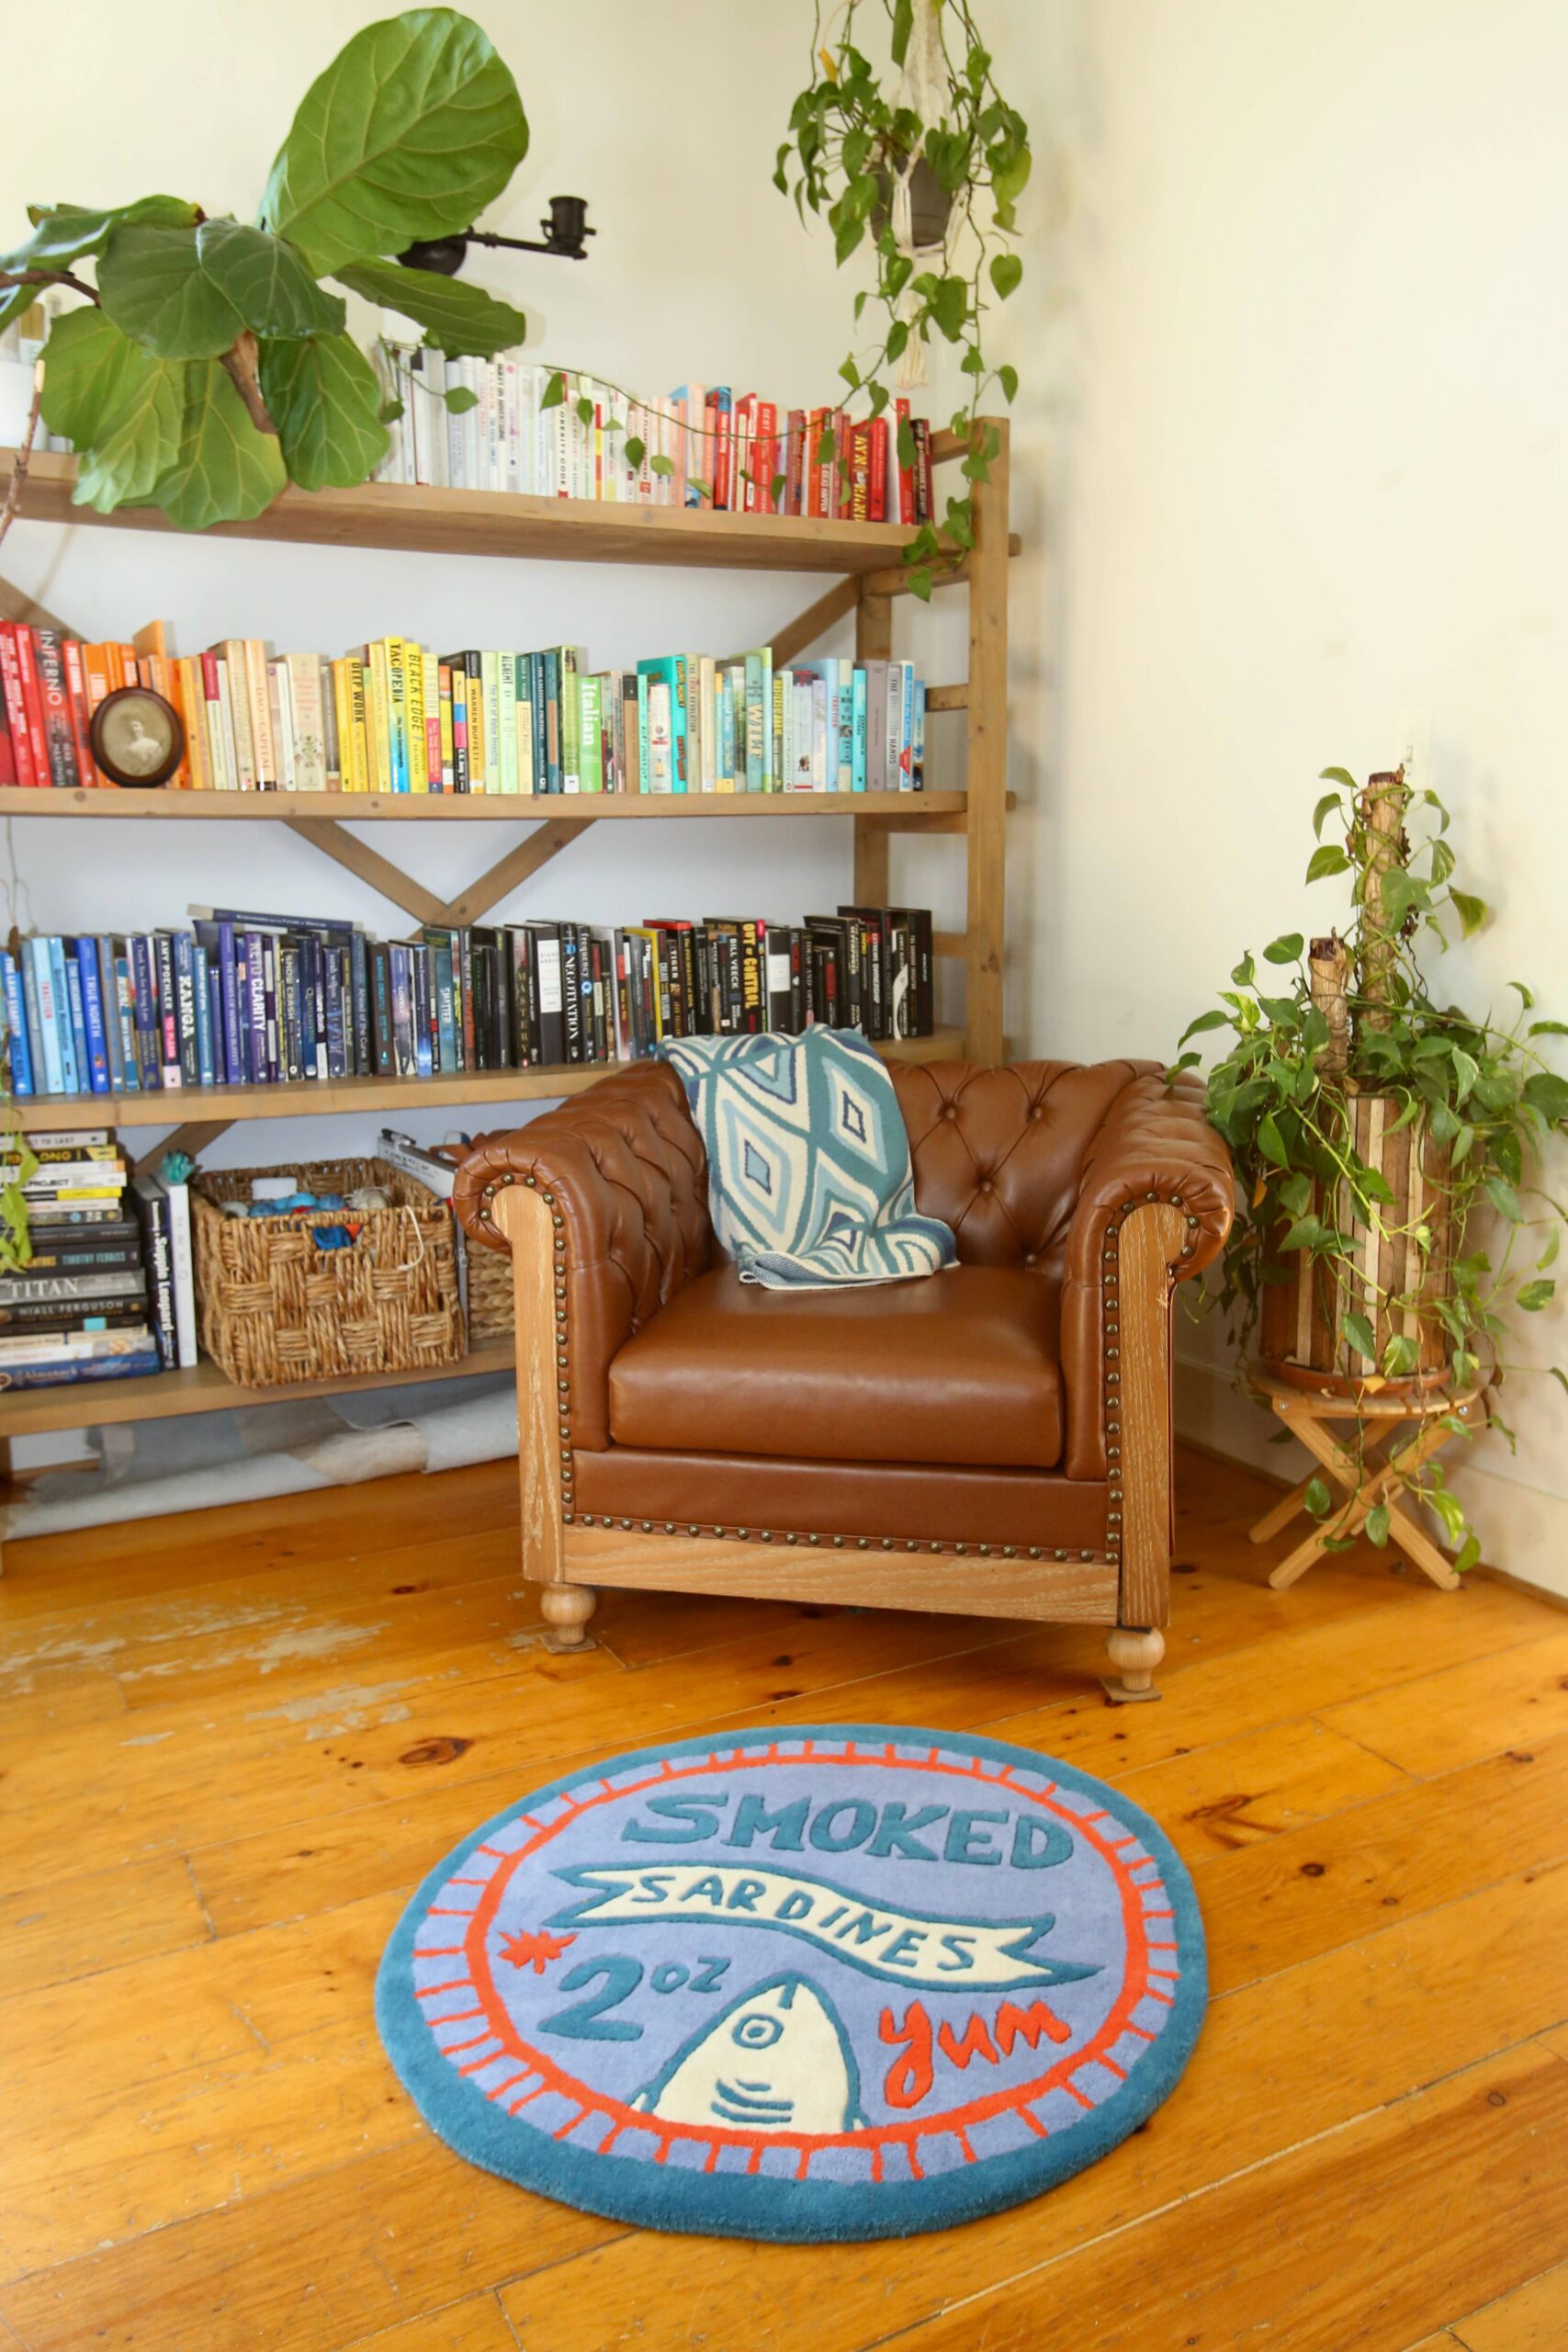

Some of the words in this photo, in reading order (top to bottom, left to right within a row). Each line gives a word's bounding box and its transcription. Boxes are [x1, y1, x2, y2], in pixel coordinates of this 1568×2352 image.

[761, 408, 770, 431] DEBT
[854, 435, 868, 465] AYN
[853, 484, 866, 522] RAND
[39, 631, 62, 706] INFERNO
[351, 662, 363, 687] DEEP
[409, 654, 423, 694] BLACK
[502, 656, 513, 684] ALCHEMY
[255, 687, 265, 713] DAO
[353, 691, 366, 724] WORK
[411, 699, 424, 731] EDGE
[581, 683, 600, 746] Italian
[258, 722, 270, 769] CAPITAL
[748, 703, 763, 758] WILT
[490, 737, 498, 766] Investing
[729, 938, 739, 957] BILL
[742, 923, 756, 945] OUT
[871, 933, 879, 962] EXTREME
[6, 957, 16, 974] THE
[136, 944, 145, 964] Thank
[160, 940, 170, 963] AMY
[249, 942, 263, 975] KETO
[580, 933, 589, 978] frequency
[285, 954, 293, 984] SNOW
[659, 962, 668, 982] CREATE
[730, 959, 739, 989] VEECK
[743, 957, 759, 1009] CONTROL
[7, 975, 19, 999] LEAN
[40, 980, 54, 1020] TRACTION
[86, 975, 96, 1001] TRUE
[163, 965, 173, 1010] POEHLER
[357, 988, 367, 1012] Ahead
[565, 956, 579, 1040] NEGOTIATION
[8, 1000, 21, 1037] STARTUP
[178, 974, 195, 1039] KANGA
[251, 978, 265, 1031] CLARITY
[286, 986, 294, 1021] CRASH
[359, 1013, 367, 1022] of
[441, 987, 451, 1024] SHATTER
[661, 994, 670, 1020] RELIGION
[89, 1004, 101, 1037] NORTH
[317, 1012, 325, 1033] deals
[359, 1023, 367, 1036] the
[359, 1037, 368, 1059] Curve
[55, 1136, 73, 1145] LAST
[28, 1179, 70, 1187] PROJECT
[62, 1253, 95, 1266] TIMOTHY
[153, 1237, 167, 1280] Supple
[7, 1278, 79, 1298] TITAN
[18, 1306, 53, 1317] NIALL
[59, 1300, 124, 1313] FERGUSON
[158, 1282, 175, 1331] Leopard
[621, 1792, 1074, 1869] SMOKED
[630, 1873, 978, 1972] SARDINES
